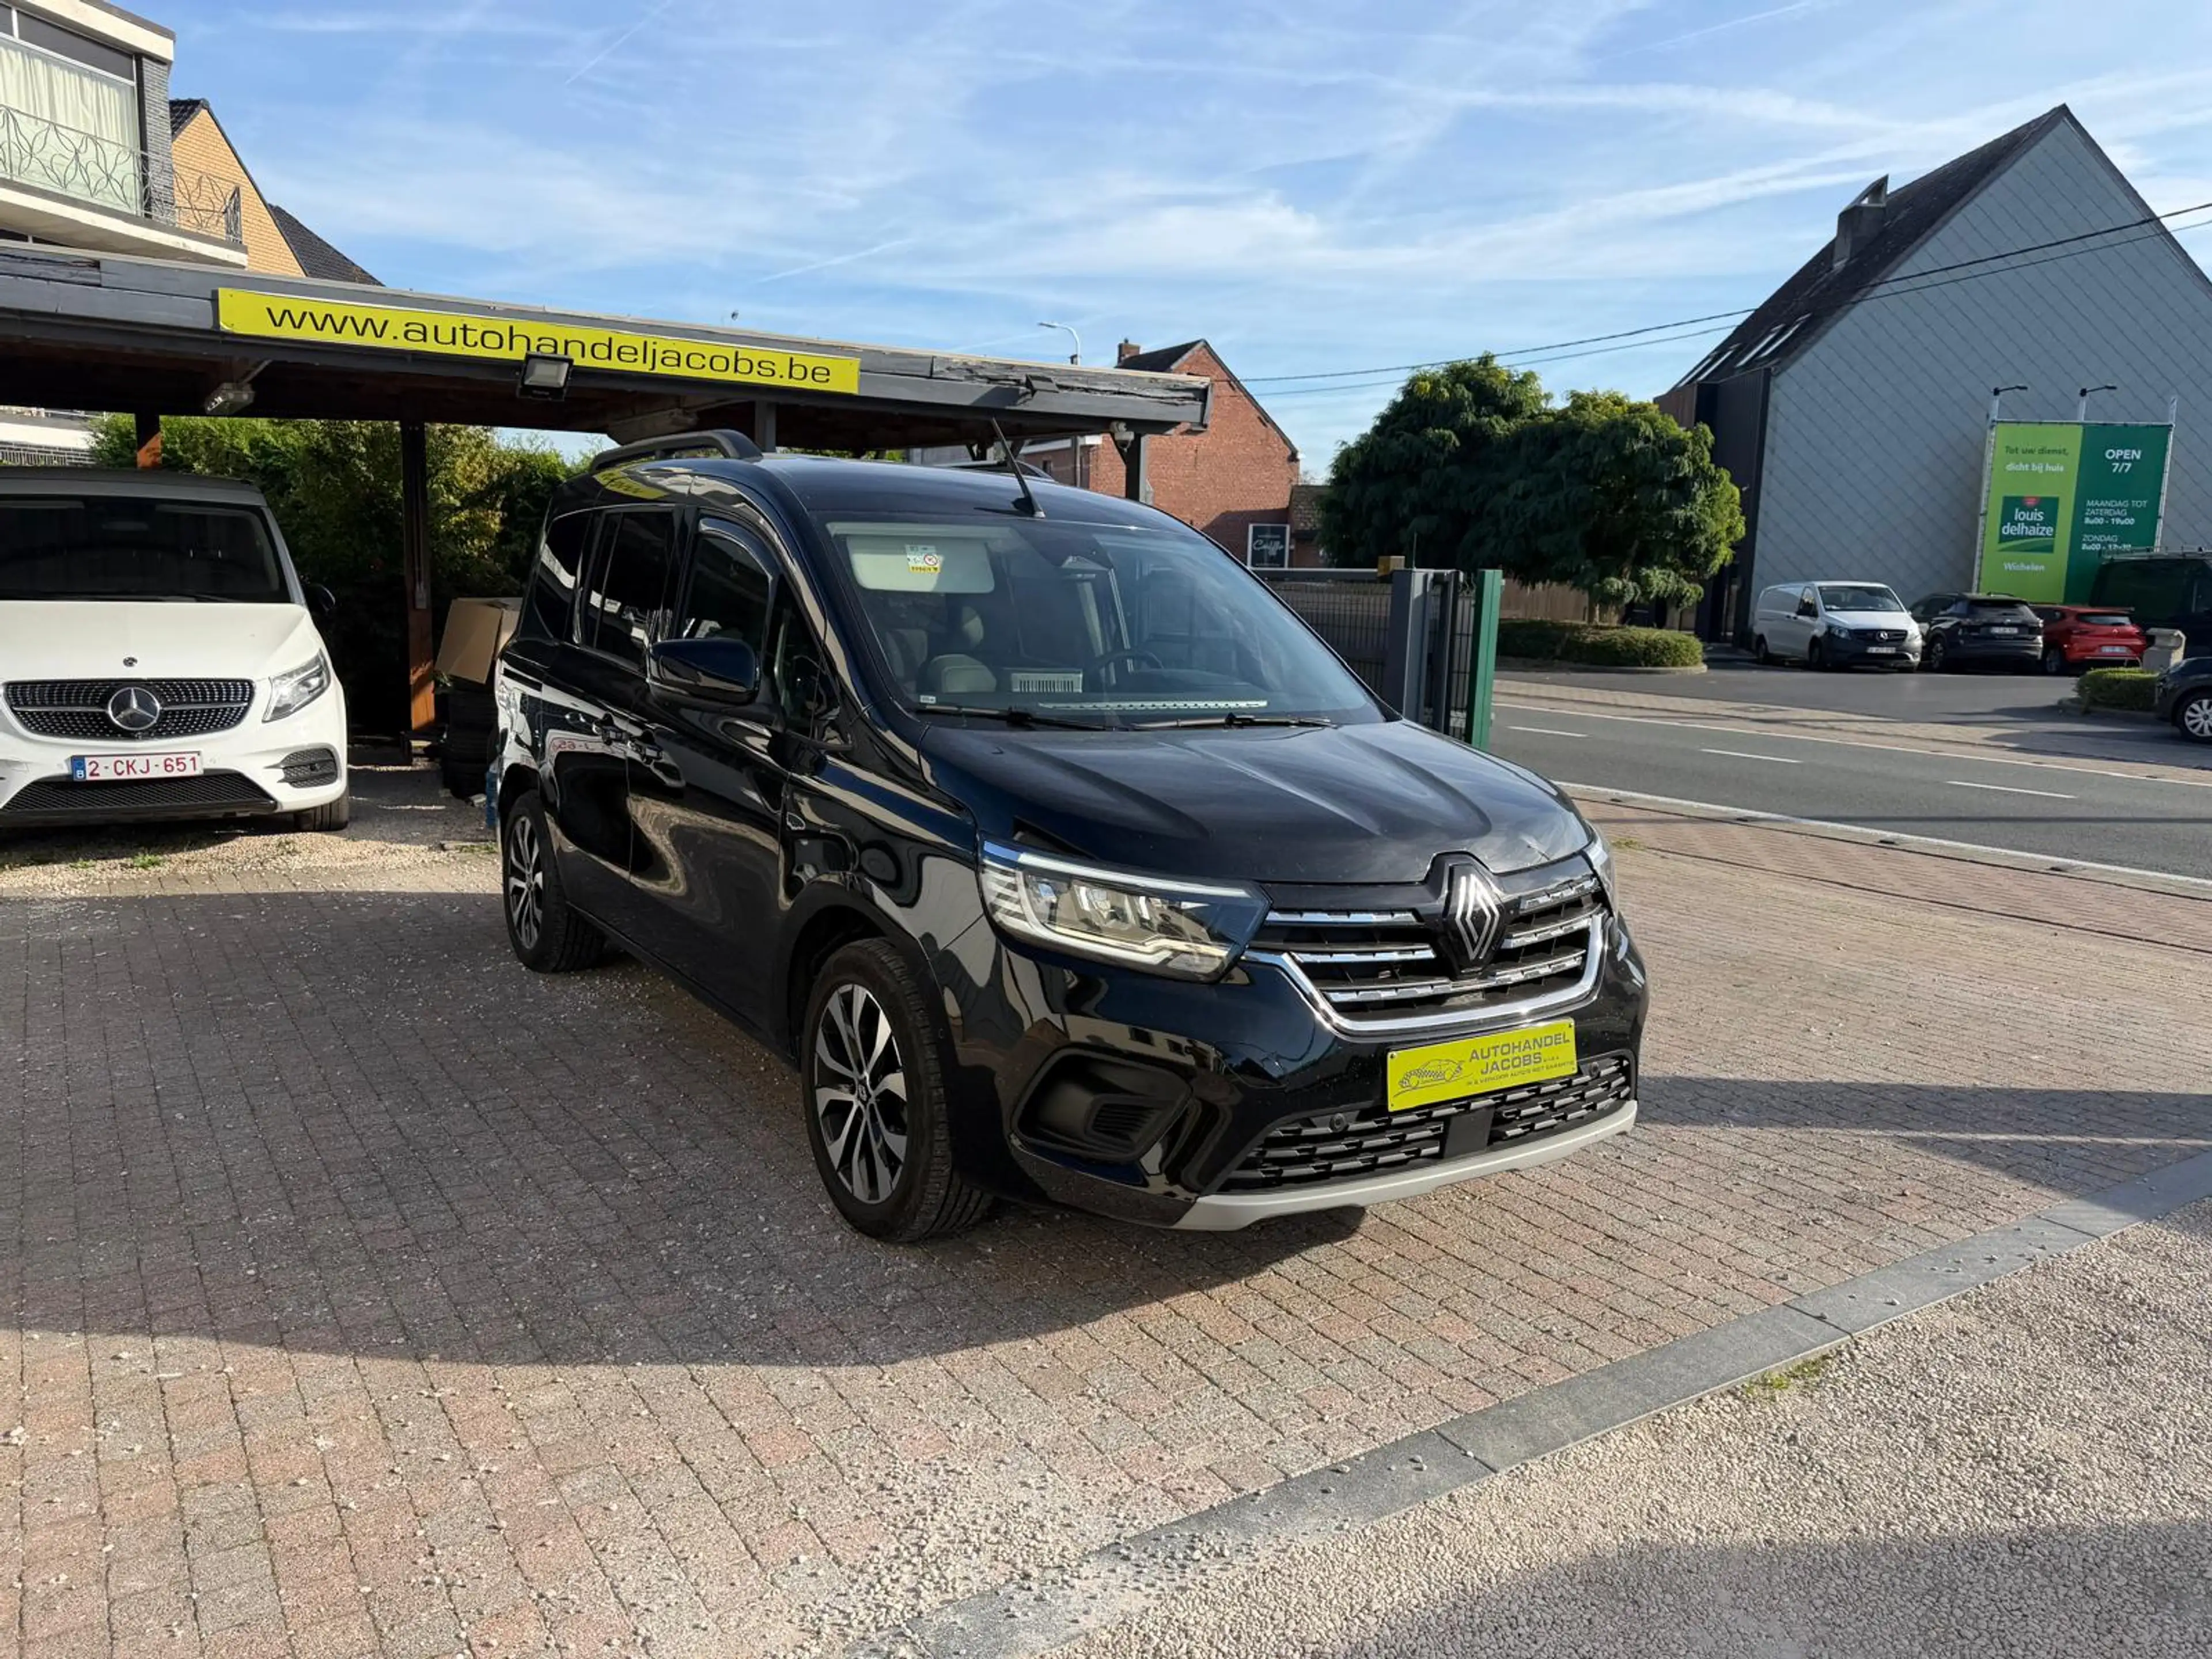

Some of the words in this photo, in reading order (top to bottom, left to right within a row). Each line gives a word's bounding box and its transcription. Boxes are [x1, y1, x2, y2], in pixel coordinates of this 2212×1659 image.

[267, 306, 831, 385] www.autohandeljacobs.be
[2105, 449, 2142, 460] OPEN
[2112, 463, 2132, 472] 7/7
[2014, 507, 2044, 521] louis
[2085, 508, 2127, 516] ZATERDAG
[2002, 522, 2054, 536] delhaize
[2082, 534, 2118, 542] ZONDAG
[76, 770, 84, 778] B
[88, 757, 197, 777] 2-CKJ-651
[1469, 1031, 1571, 1062] AUTOHANDEL
[1480, 1052, 1542, 1075] JACOBS
